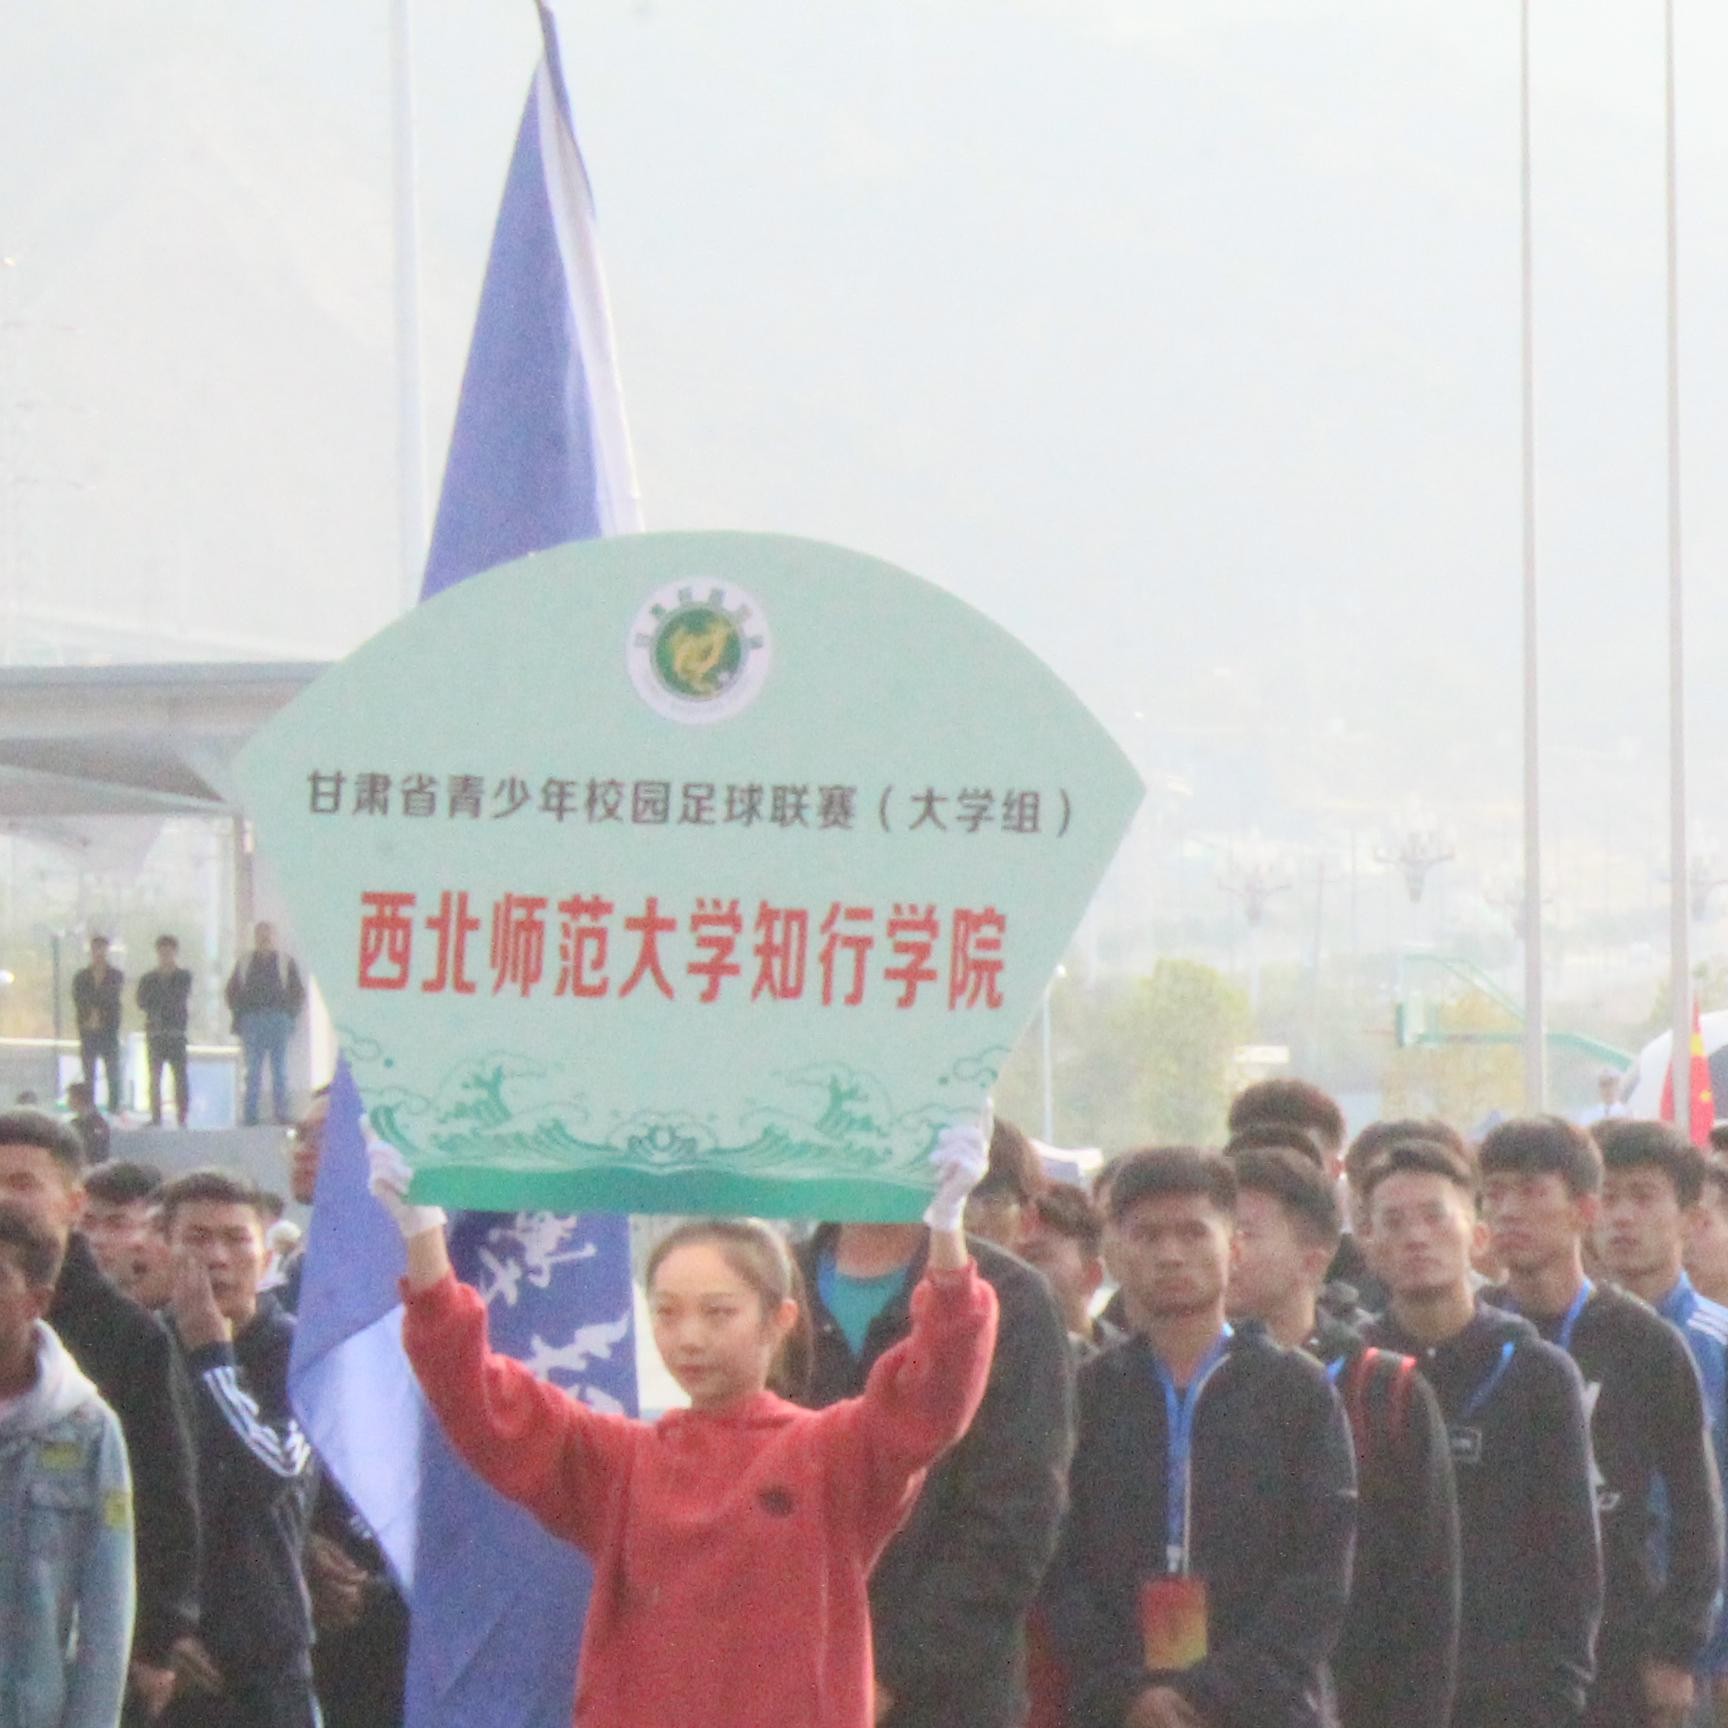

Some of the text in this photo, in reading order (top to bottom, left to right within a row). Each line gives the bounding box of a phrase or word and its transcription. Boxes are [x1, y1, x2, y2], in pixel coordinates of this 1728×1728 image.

[356, 889, 1007, 1012] 西北师范大学知行学院
